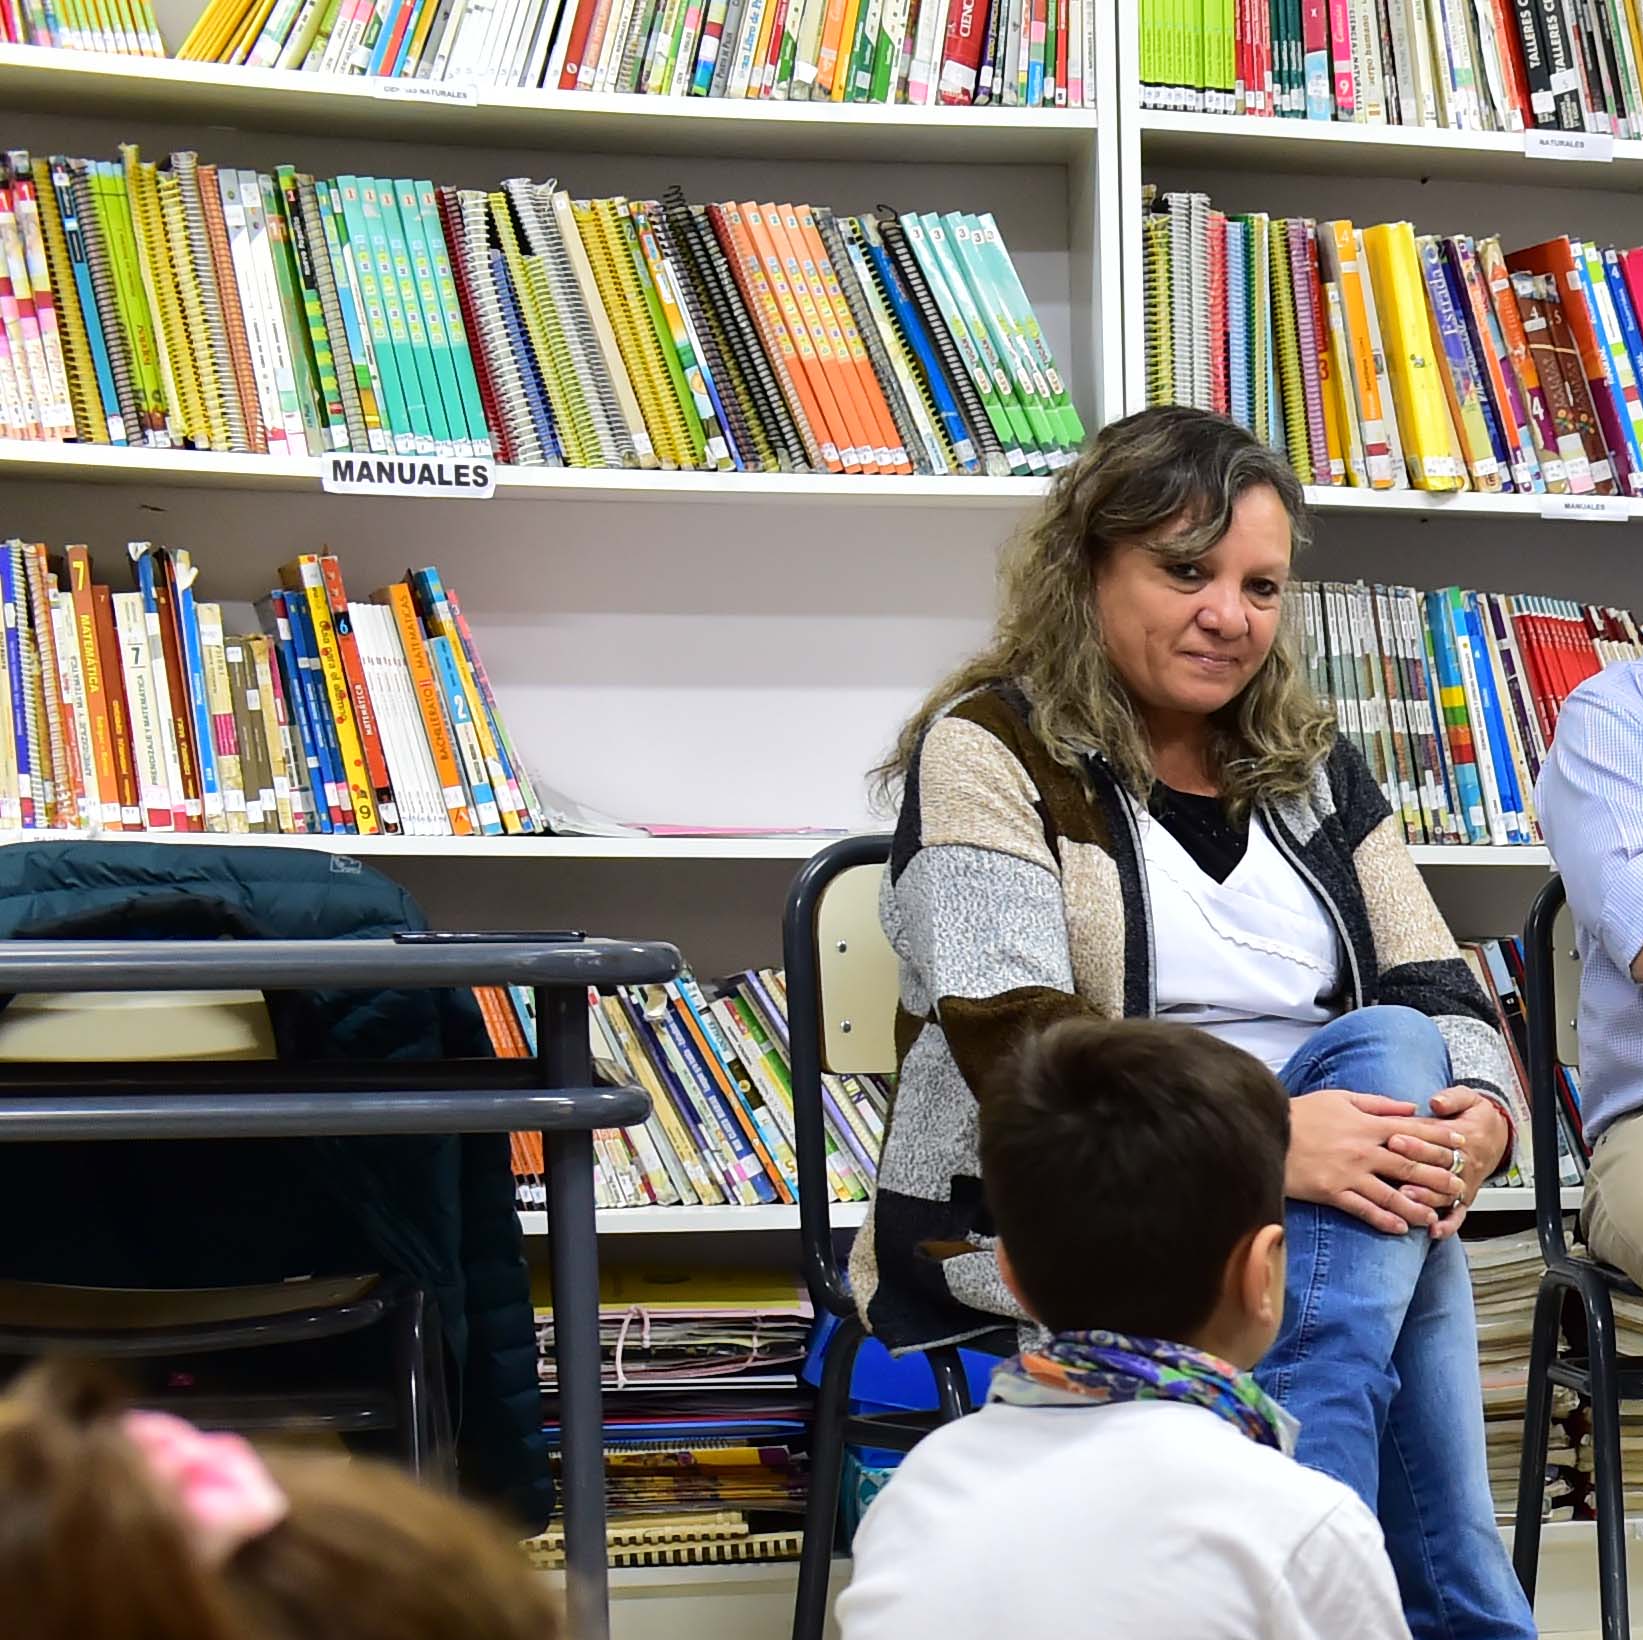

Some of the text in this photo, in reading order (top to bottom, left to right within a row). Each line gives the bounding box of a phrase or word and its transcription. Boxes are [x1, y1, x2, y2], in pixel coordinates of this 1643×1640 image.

[1520, 7, 1541, 68] TALLERES
[1539, 140, 1585, 149] NATURALES
[1429, 267, 1457, 336] Estrada
[1532, 396, 1545, 421] 4
[332, 459, 488, 488] MANUALES
[1564, 503, 1605, 511] MANUALES
[73, 560, 100, 693] 7 MATEMÁTICA
[132, 646, 140, 666] 7
[324, 647, 339, 668] para
[331, 683, 348, 720] alumno
[454, 696, 467, 719] 2
[422, 687, 448, 760] BACHILLERATO
